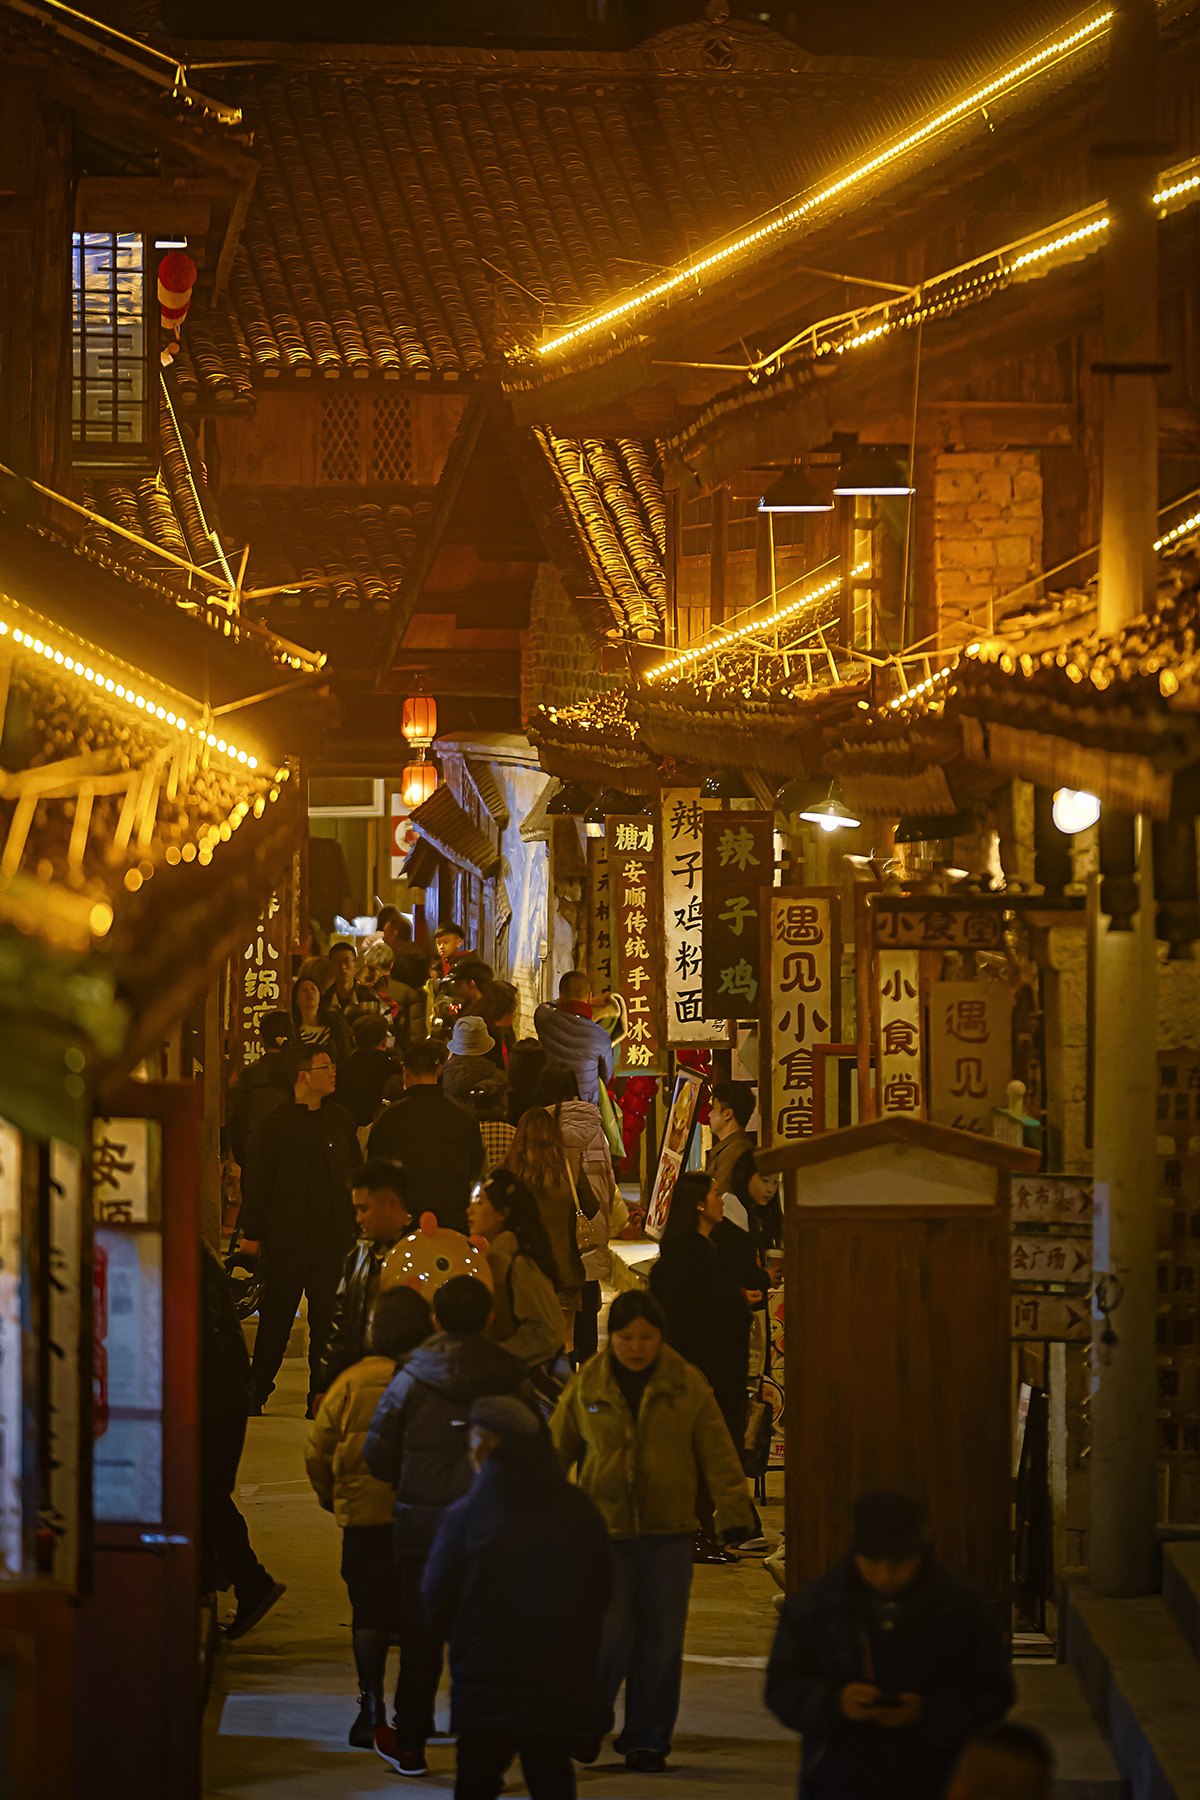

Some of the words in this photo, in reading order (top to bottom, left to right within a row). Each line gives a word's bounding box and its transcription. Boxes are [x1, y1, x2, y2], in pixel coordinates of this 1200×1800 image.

[622, 859, 654, 1067] 安顺传统手工冰粉
[669, 800, 706, 1024] 辣子鸡粉面
[715, 826, 760, 1002] 辣子鸡
[877, 910, 1000, 944] 小食堂
[776, 905, 829, 1140] 遇见小食堂
[882, 970, 921, 1112] 小食堂
